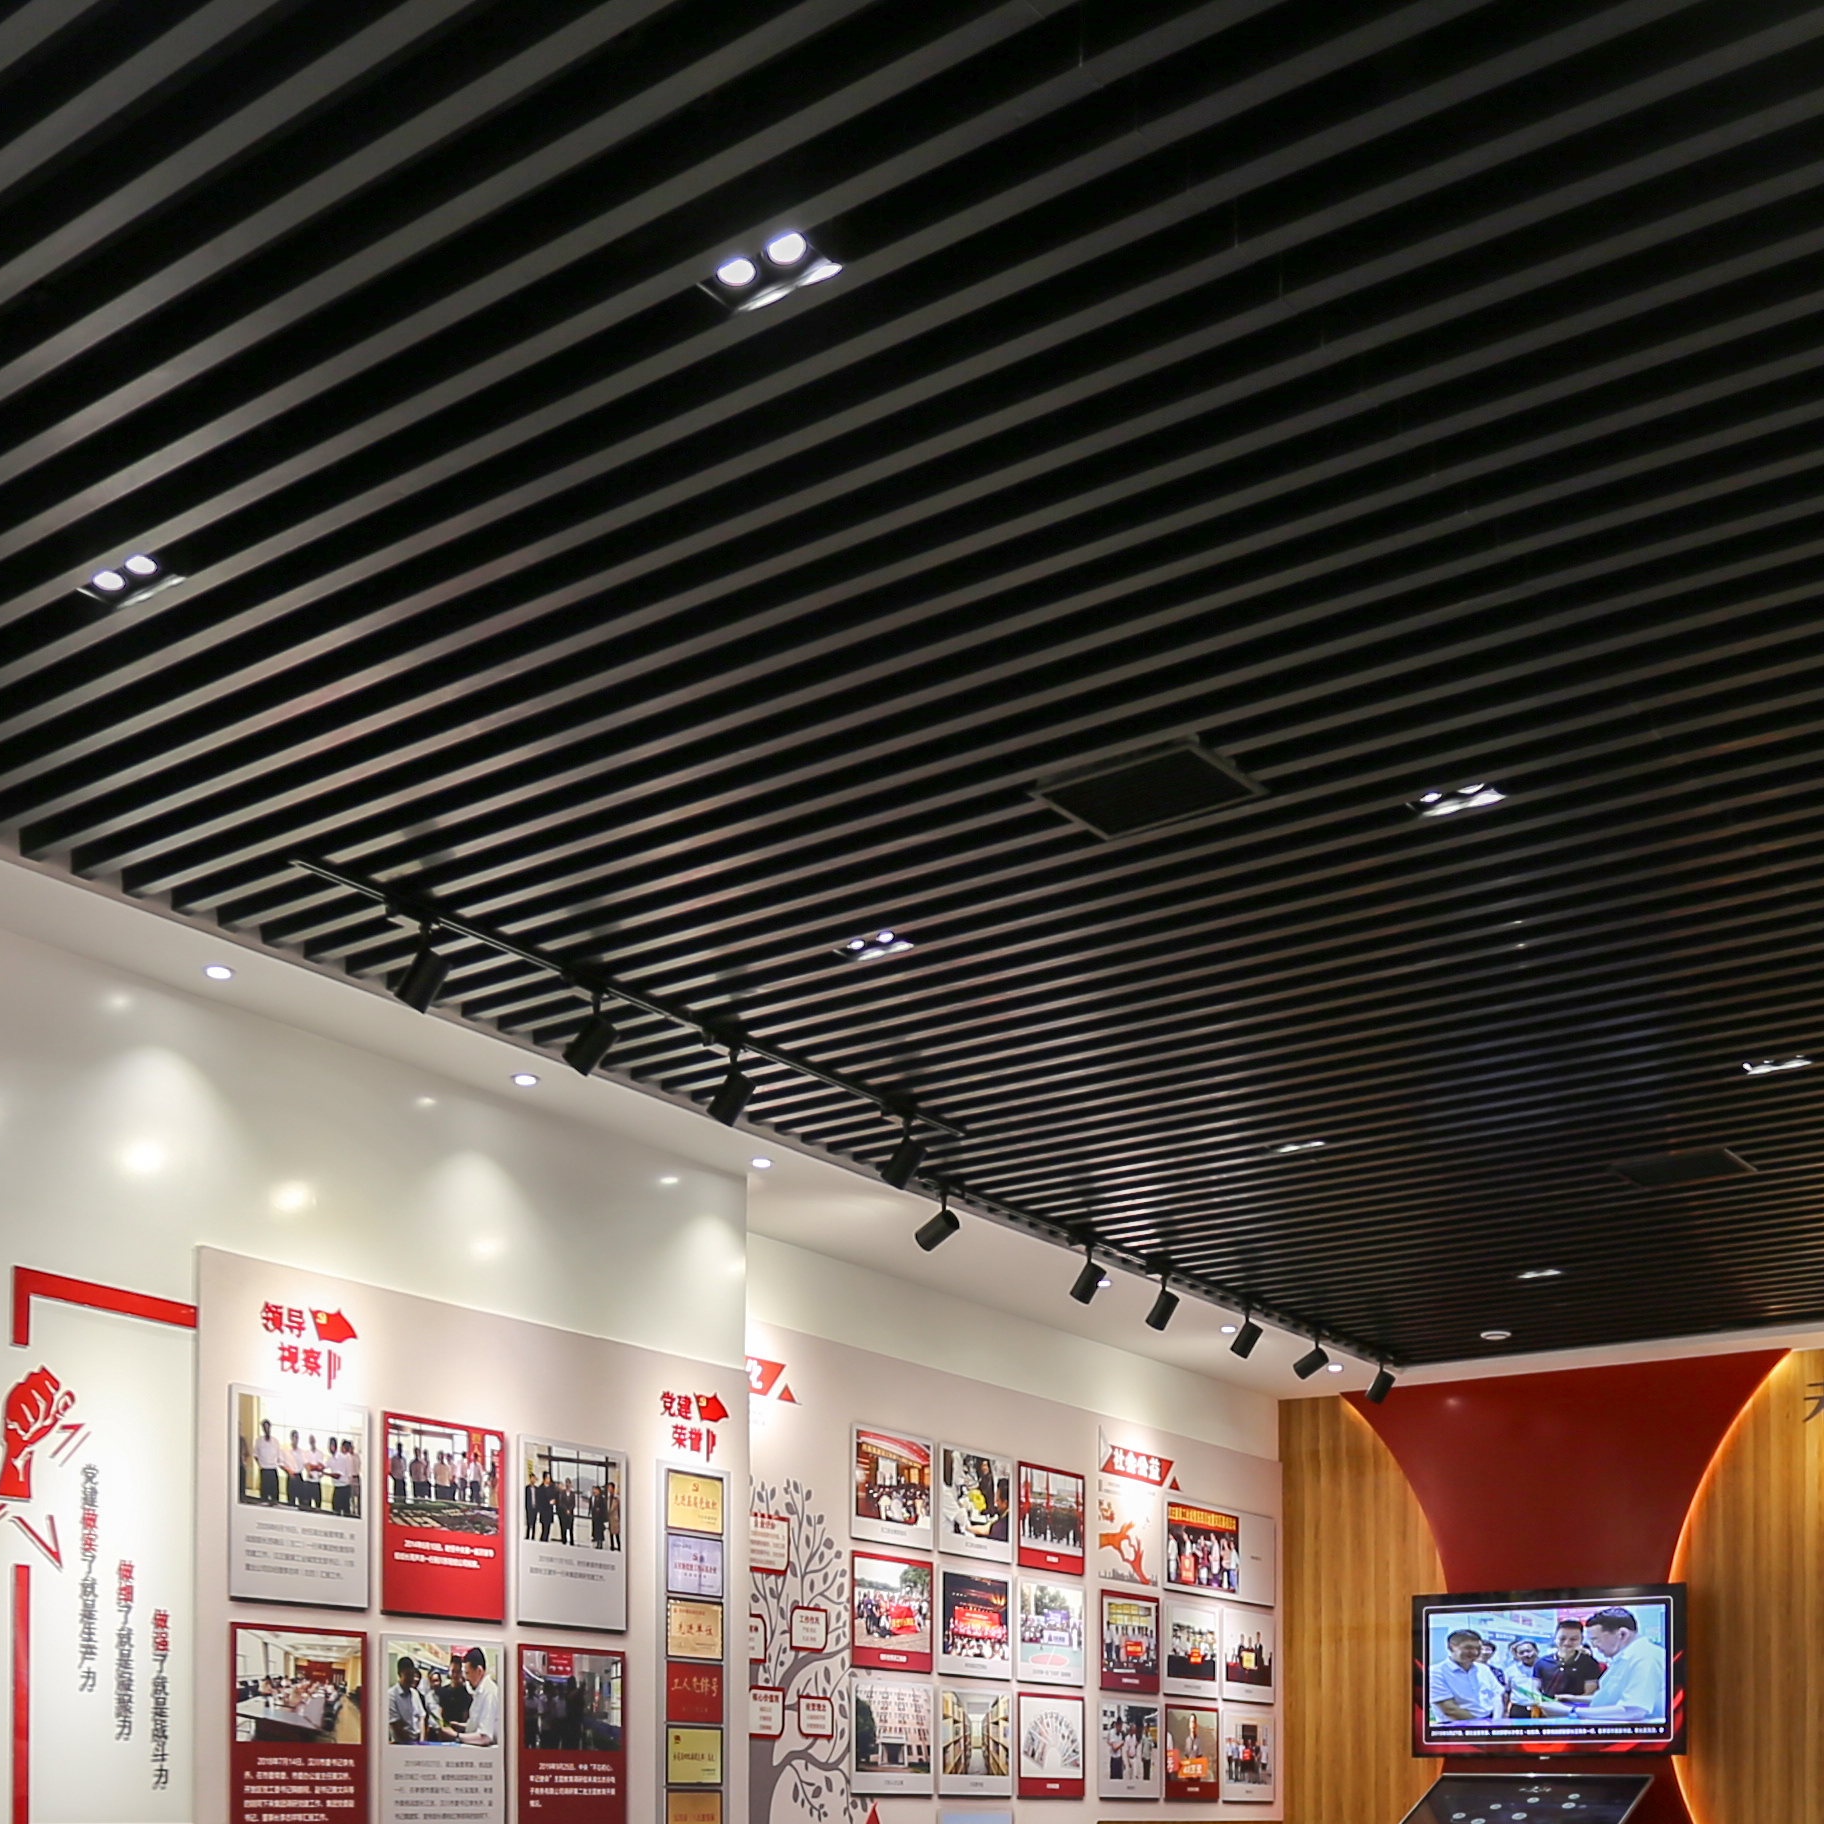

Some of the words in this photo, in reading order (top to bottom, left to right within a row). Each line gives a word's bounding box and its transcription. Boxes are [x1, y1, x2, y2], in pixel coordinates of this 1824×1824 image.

[260, 1300, 306, 1339] 领导
[277, 1341, 322, 1378] 视察
[660, 1389, 693, 1421] 党建
[671, 1423, 704, 1454] 荣誉
[1112, 1447, 1162, 1482] 社会公益
[79, 1461, 99, 1693] 党建做实了就是生产力
[677, 1622, 715, 1637] 先进单位
[150, 1607, 171, 1791] 做强了就是战斗力
[670, 1675, 719, 1698] 工人先锋号
